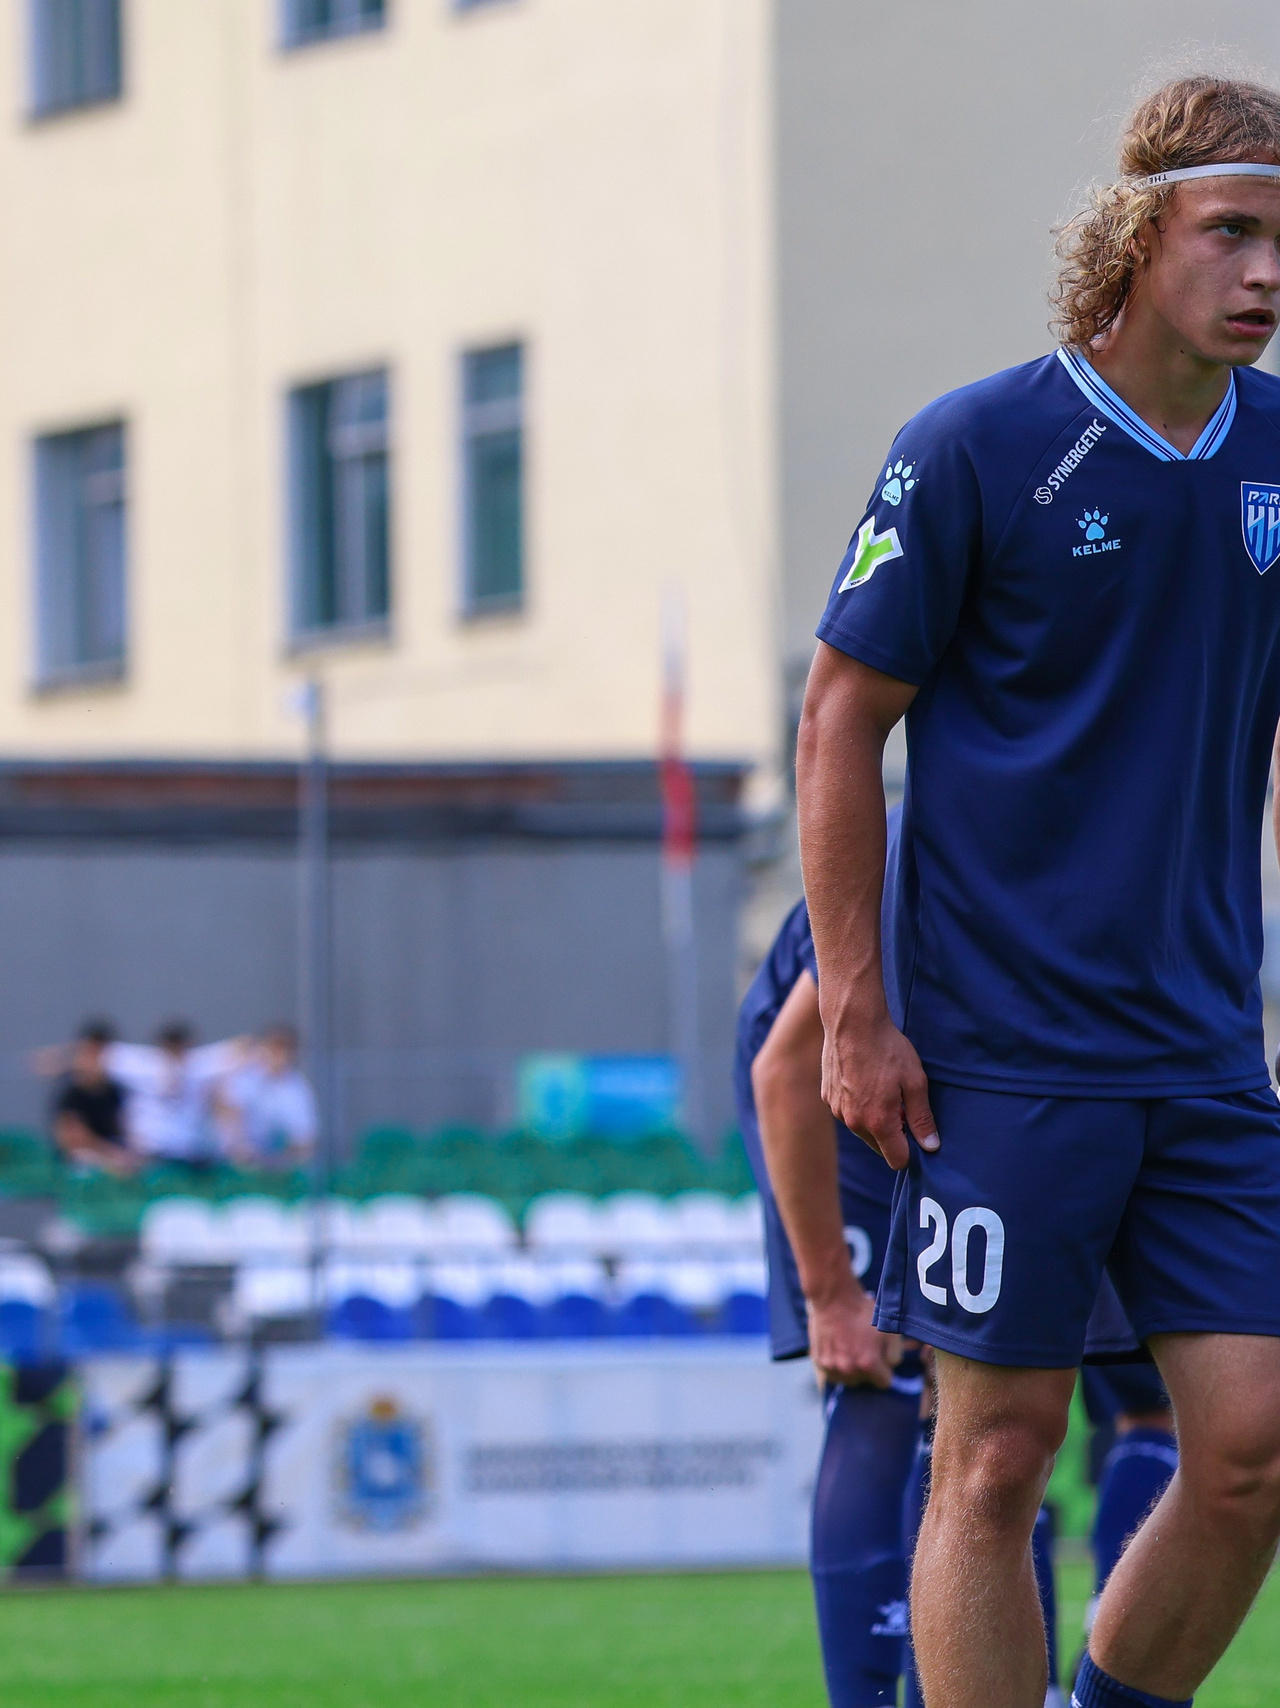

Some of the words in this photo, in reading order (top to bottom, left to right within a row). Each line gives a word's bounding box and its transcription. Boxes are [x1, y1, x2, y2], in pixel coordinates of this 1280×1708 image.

[1047, 418, 1107, 491] SYNERGETIC
[1072, 538, 1122, 557] KELME
[917, 1196, 1006, 1314] 20
